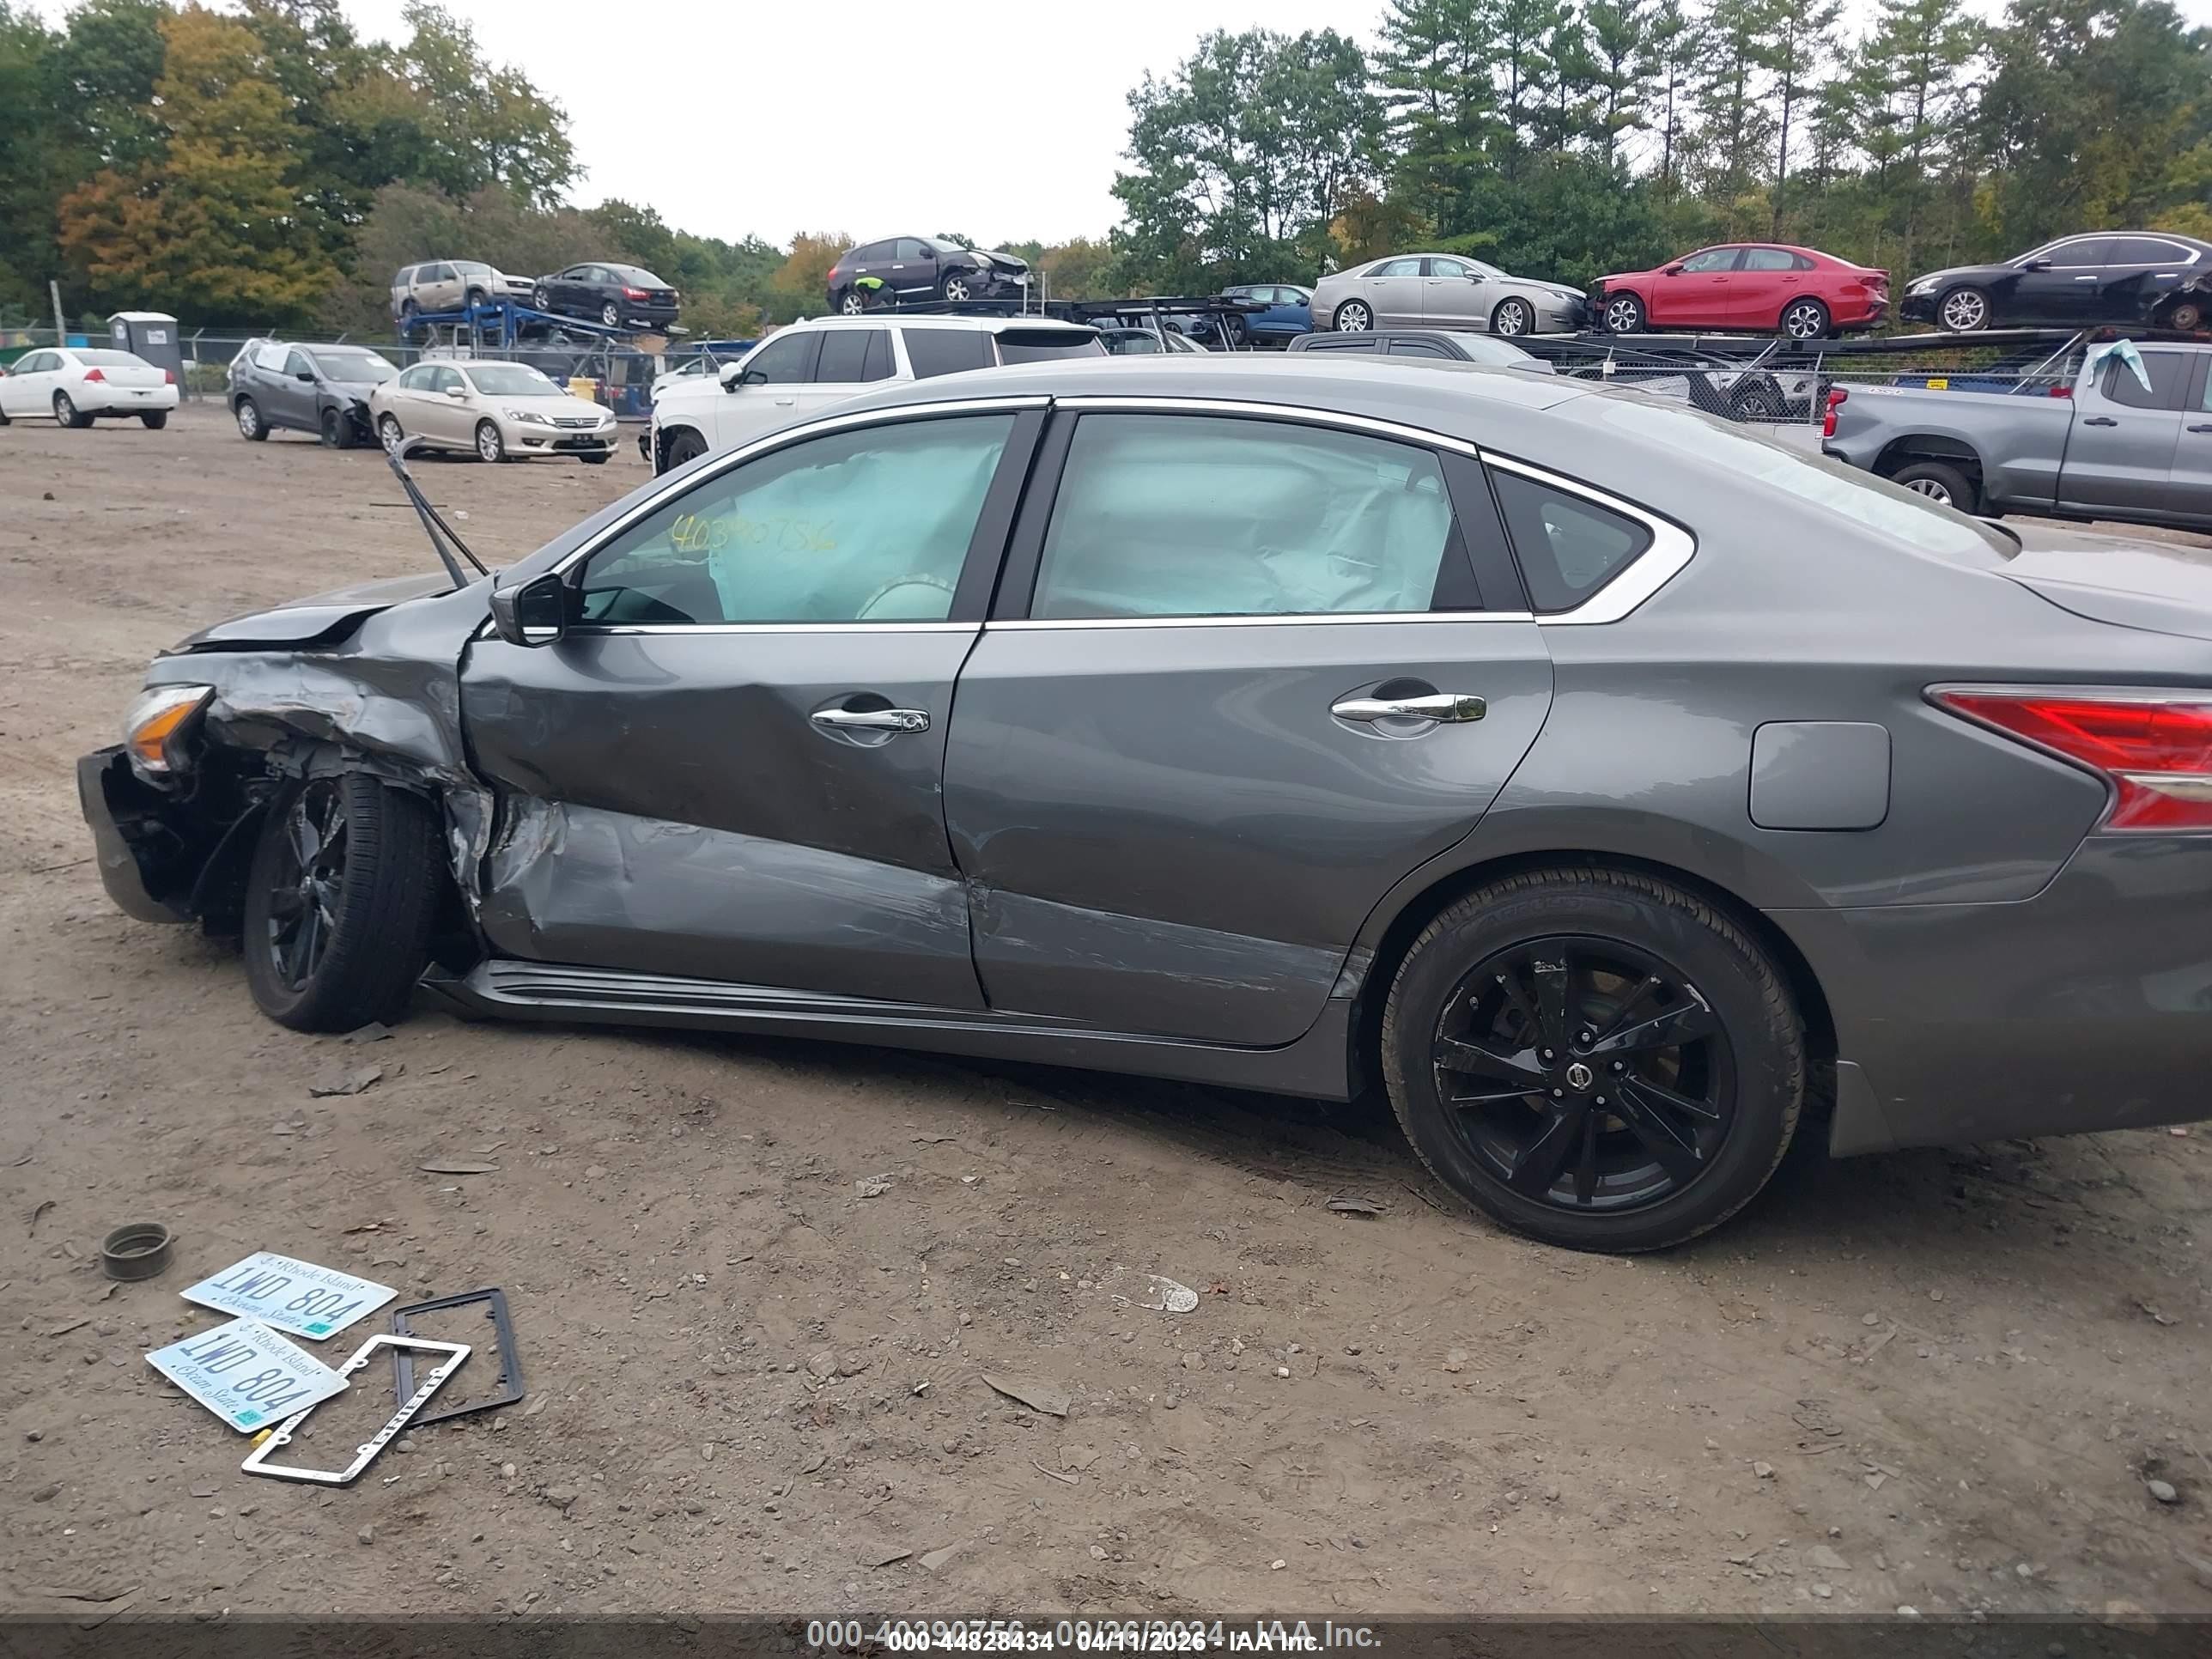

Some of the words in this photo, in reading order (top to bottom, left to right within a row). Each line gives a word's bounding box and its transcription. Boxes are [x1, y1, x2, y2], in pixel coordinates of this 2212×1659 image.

[210, 1267, 293, 1300] 1WD
[284, 1287, 365, 1323] 804
[281, 1262, 324, 1280] Rhode
[321, 1274, 361, 1291] Island
[220, 1296, 263, 1314] Ocean
[263, 1308, 301, 1325] State
[179, 1333, 258, 1375] 1WD
[232, 1368, 312, 1413] 804
[254, 1332, 289, 1356] Rhode
[284, 1351, 318, 1376] Island
[174, 1364, 211, 1390] Ocean
[204, 1387, 240, 1410] State
